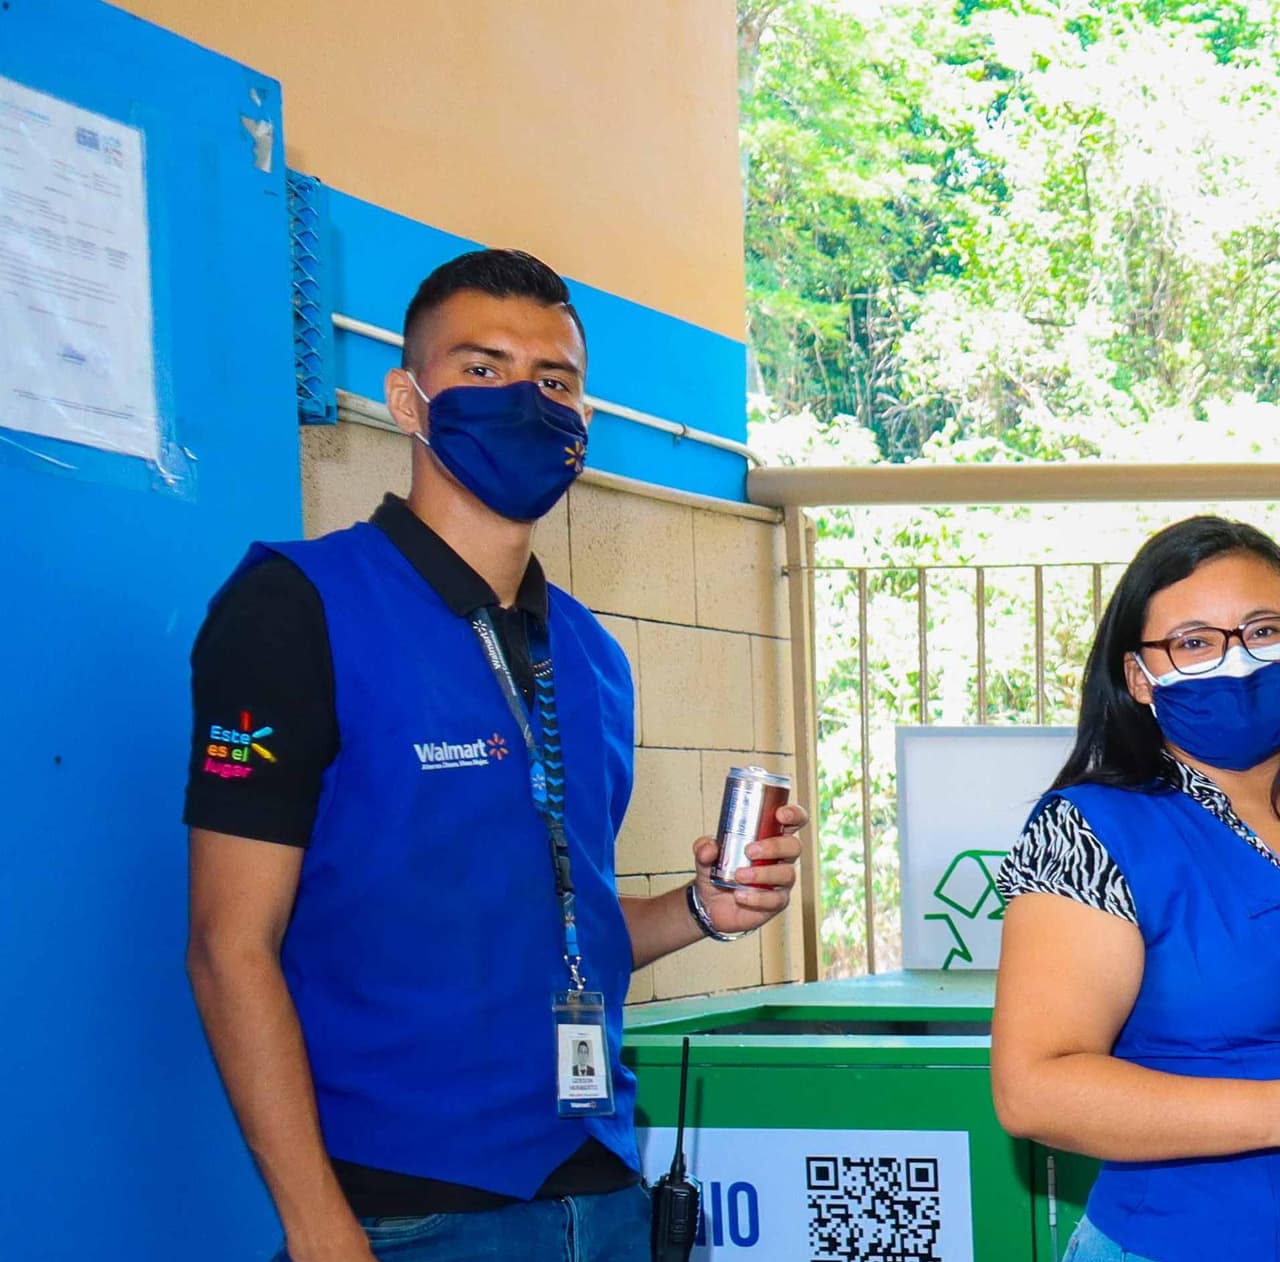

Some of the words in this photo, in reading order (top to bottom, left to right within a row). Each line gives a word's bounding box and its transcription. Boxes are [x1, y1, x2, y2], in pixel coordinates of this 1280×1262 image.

[209, 724, 252, 746] Este
[206, 744, 229, 758] es
[231, 746, 249, 762] el
[412, 738, 489, 763] Walmart
